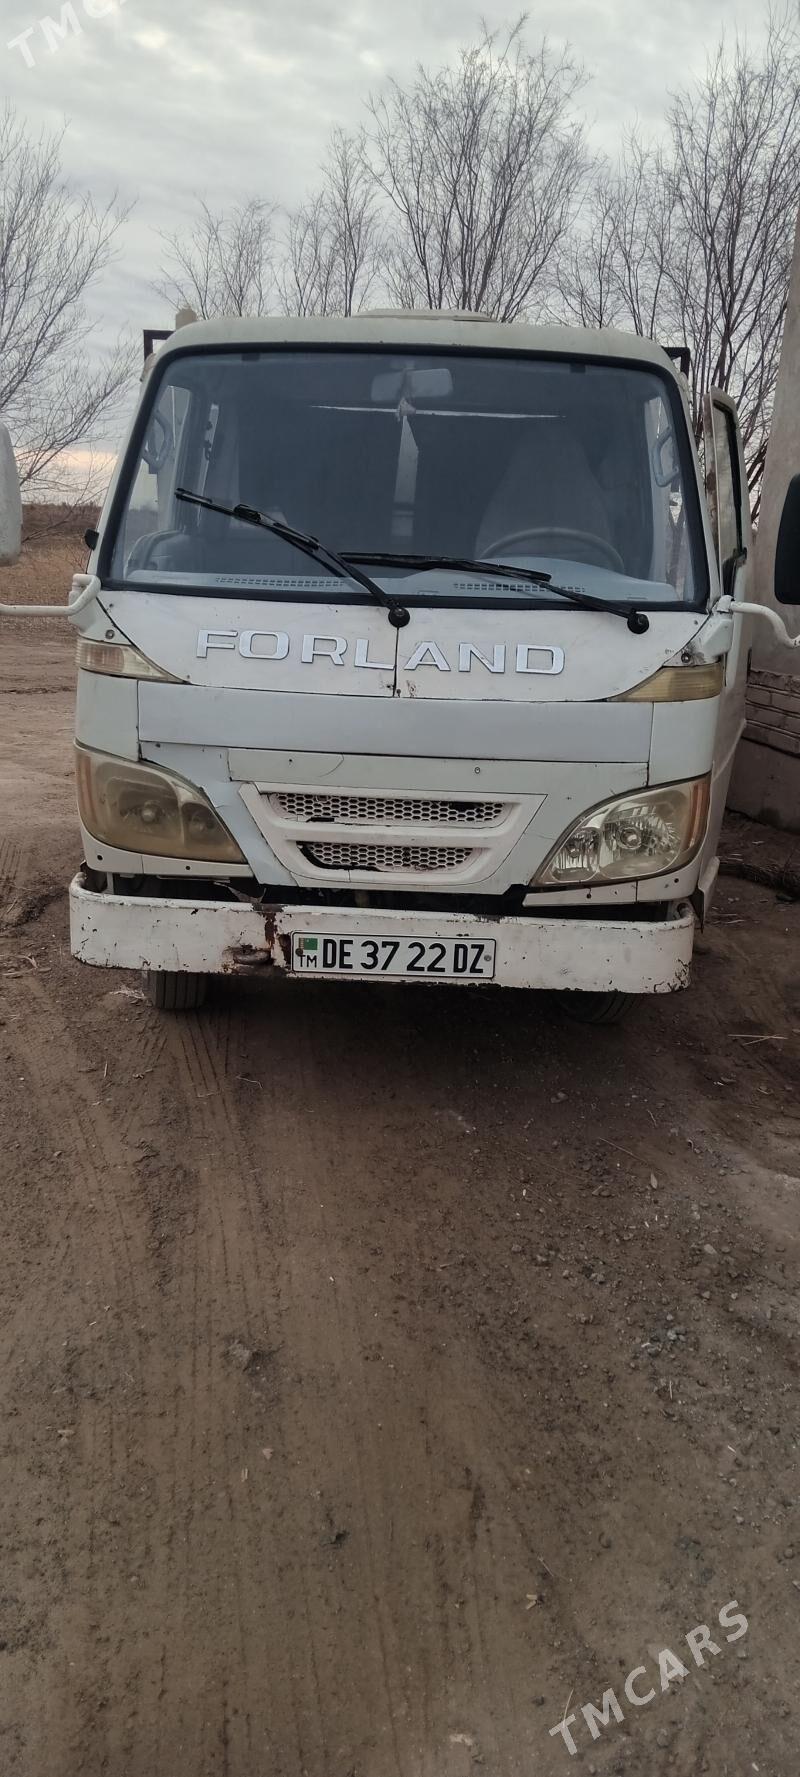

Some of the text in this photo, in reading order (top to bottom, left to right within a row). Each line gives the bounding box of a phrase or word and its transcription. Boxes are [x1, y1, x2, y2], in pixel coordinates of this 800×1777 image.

[196, 629, 565, 675] FORLAND
[299, 954, 318, 968] TM
[322, 938, 485, 974] DE 37 22 DZ
